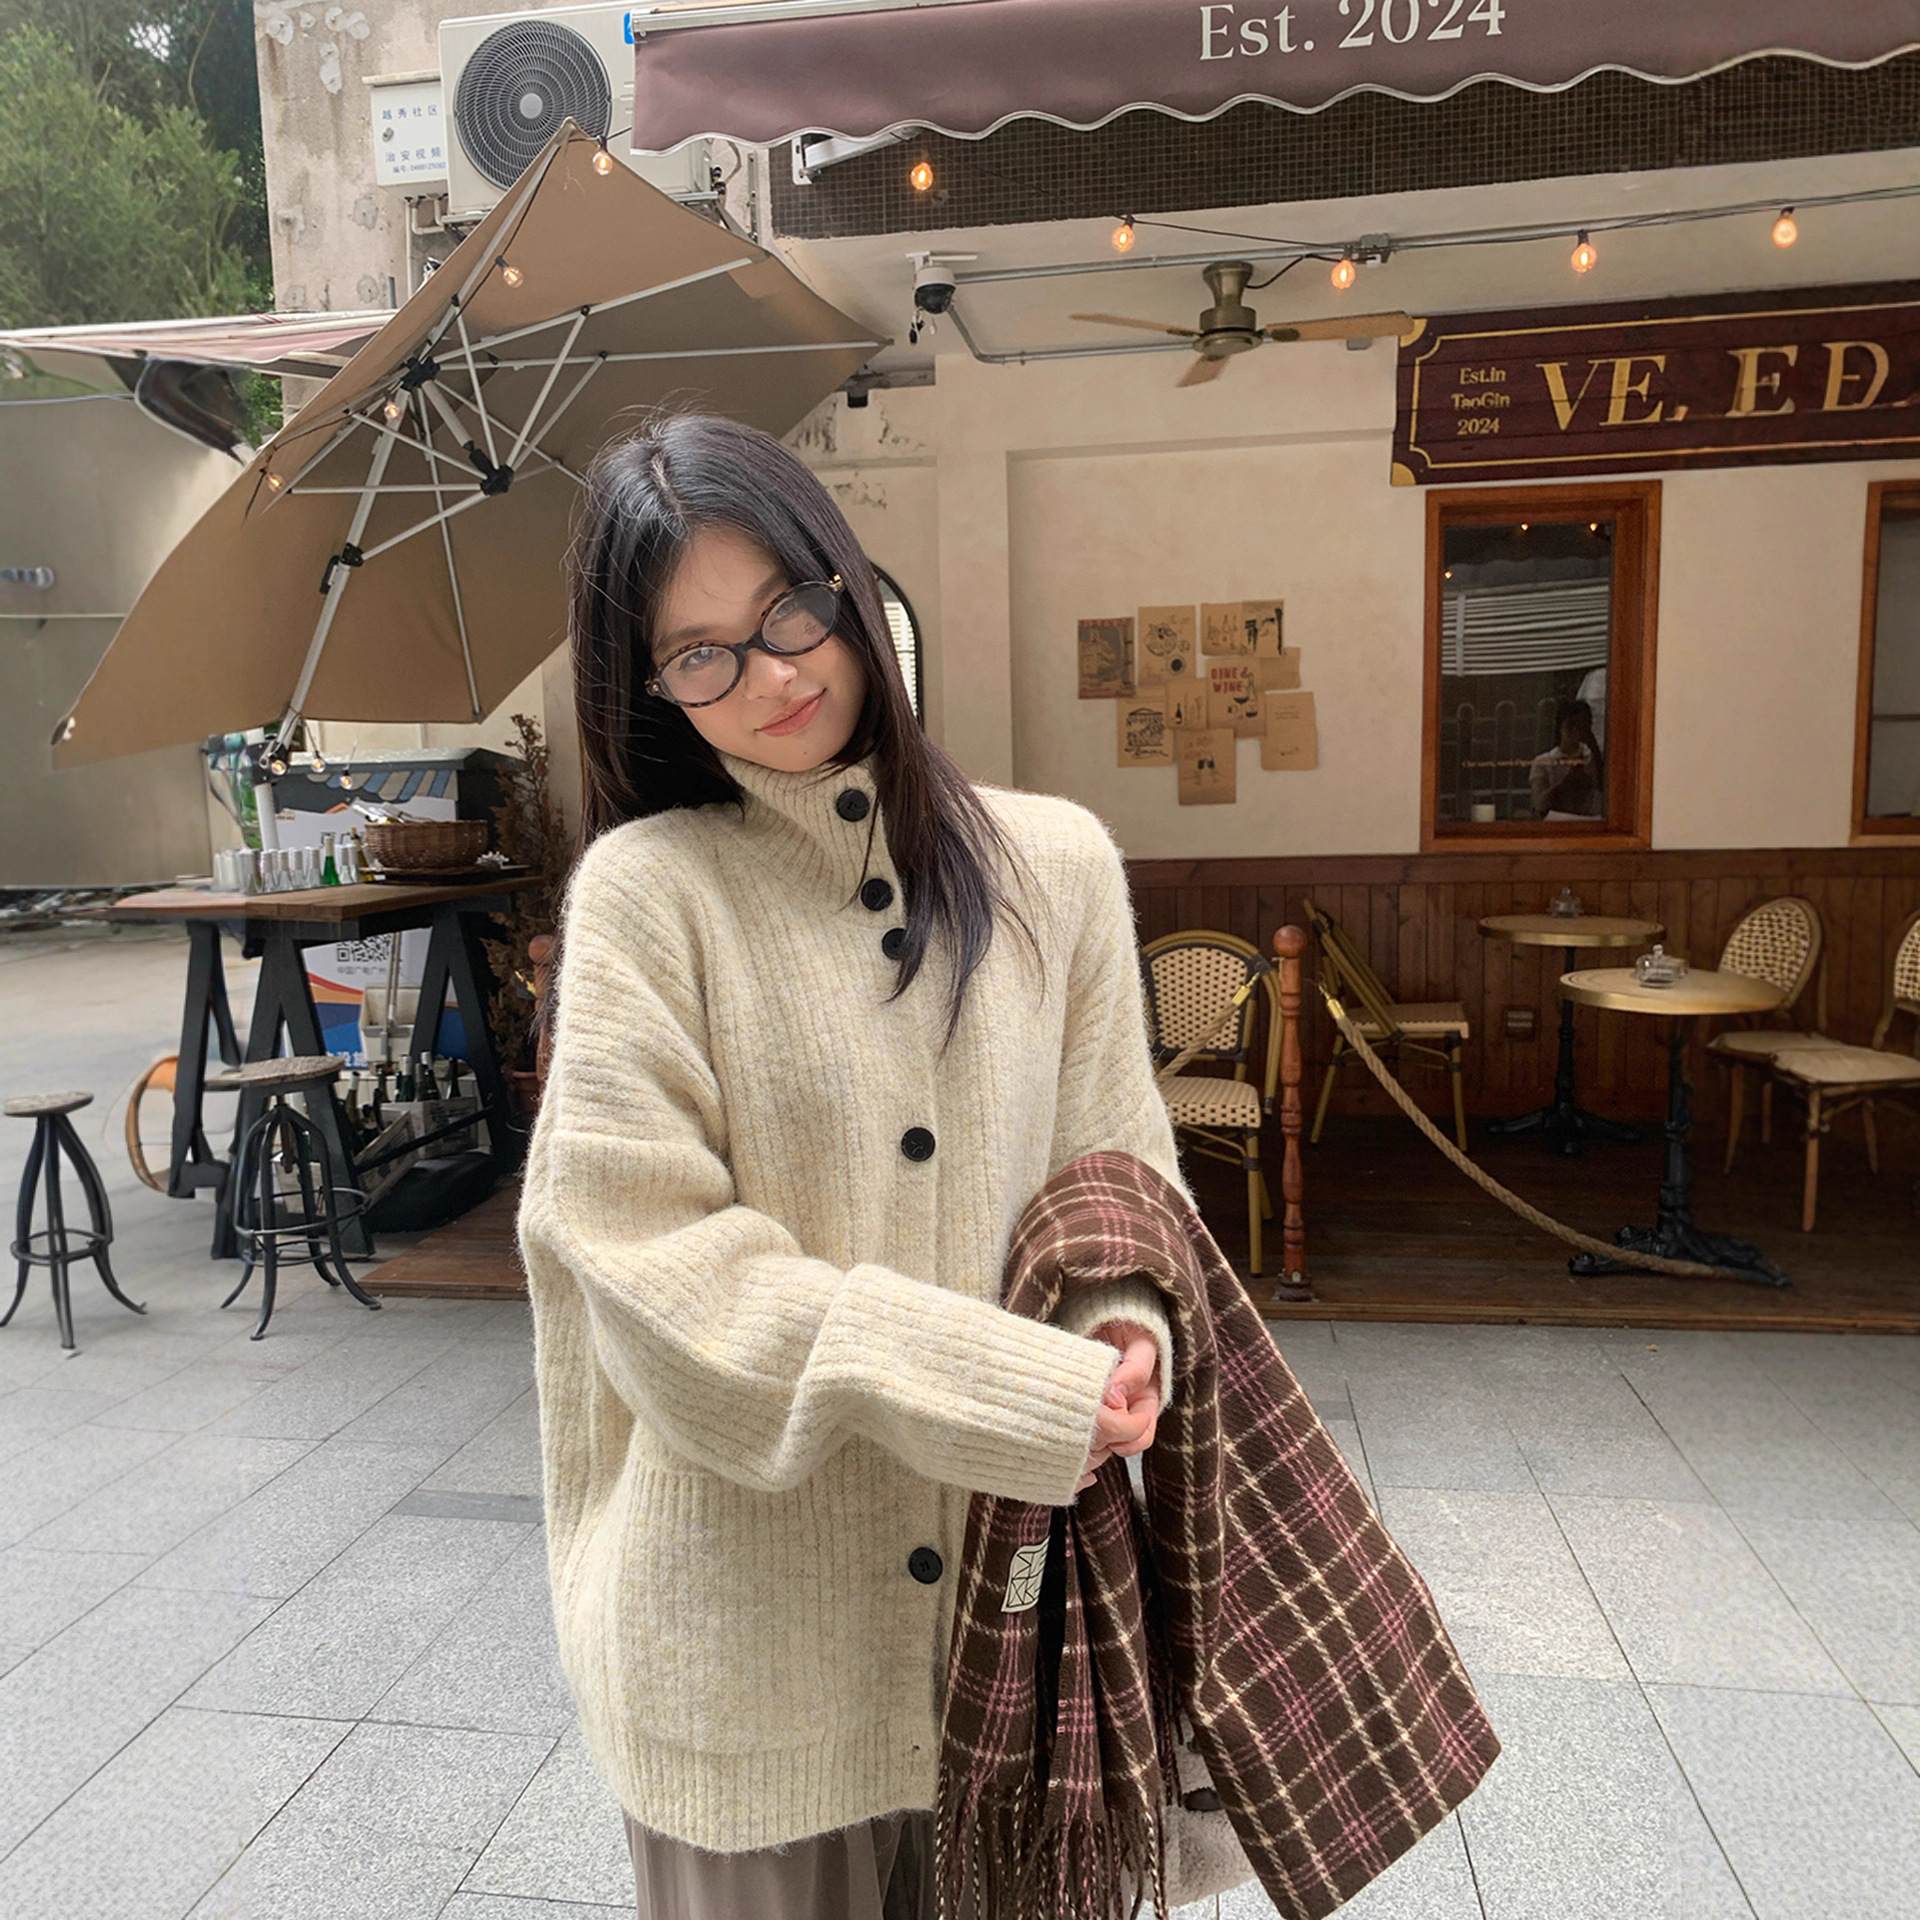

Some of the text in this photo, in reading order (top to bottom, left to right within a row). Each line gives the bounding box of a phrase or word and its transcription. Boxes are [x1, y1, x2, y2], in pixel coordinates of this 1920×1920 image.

[1200, 0, 1506, 60] Est. 2024
[382, 104, 438, 120] 越秀社区
[385, 147, 442, 162] 治安视频
[1457, 417, 1500, 435] 2024
